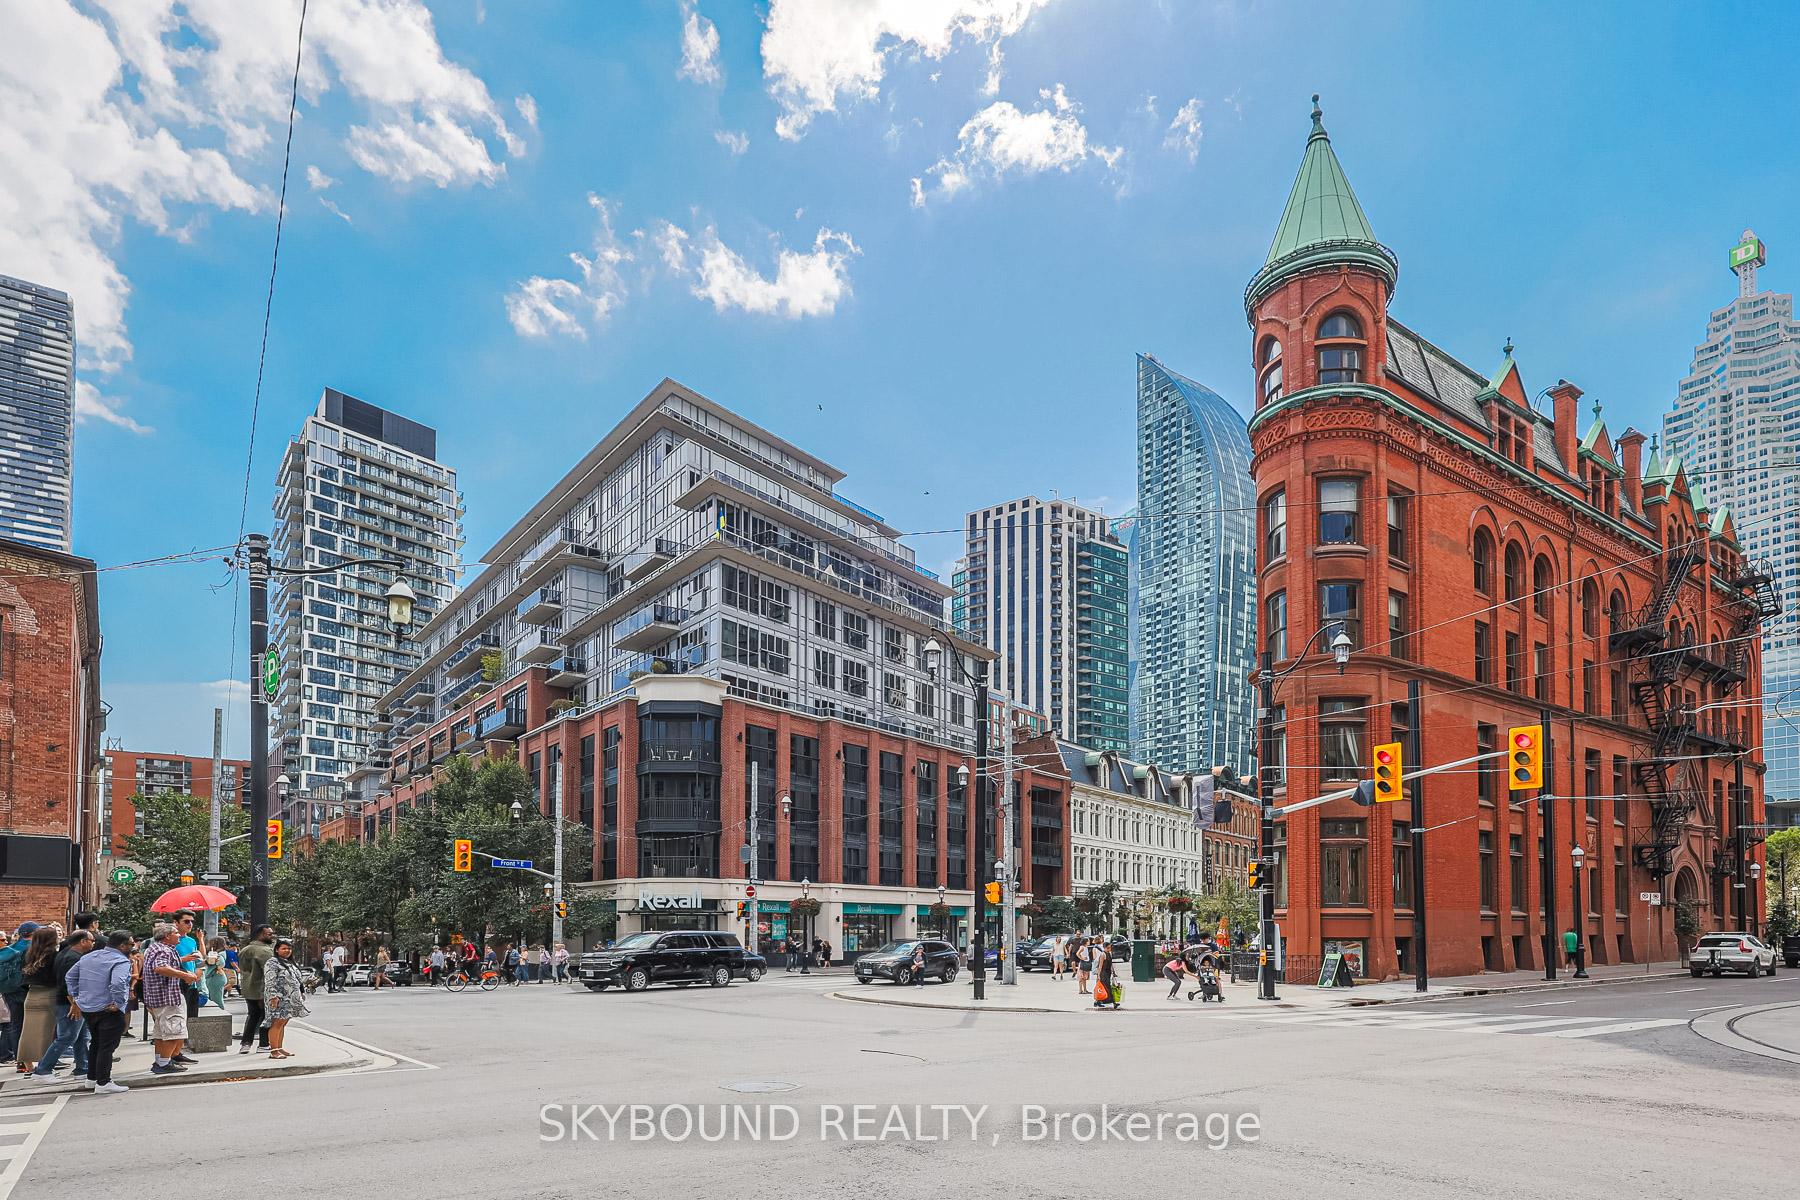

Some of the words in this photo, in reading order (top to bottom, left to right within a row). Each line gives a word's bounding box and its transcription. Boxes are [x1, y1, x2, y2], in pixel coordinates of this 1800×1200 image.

[1732, 244, 1754, 260] TD
[268, 658, 276, 682] P
[118, 871, 129, 880] P
[639, 890, 702, 910] Rexall
[762, 903, 780, 911] Rexall
